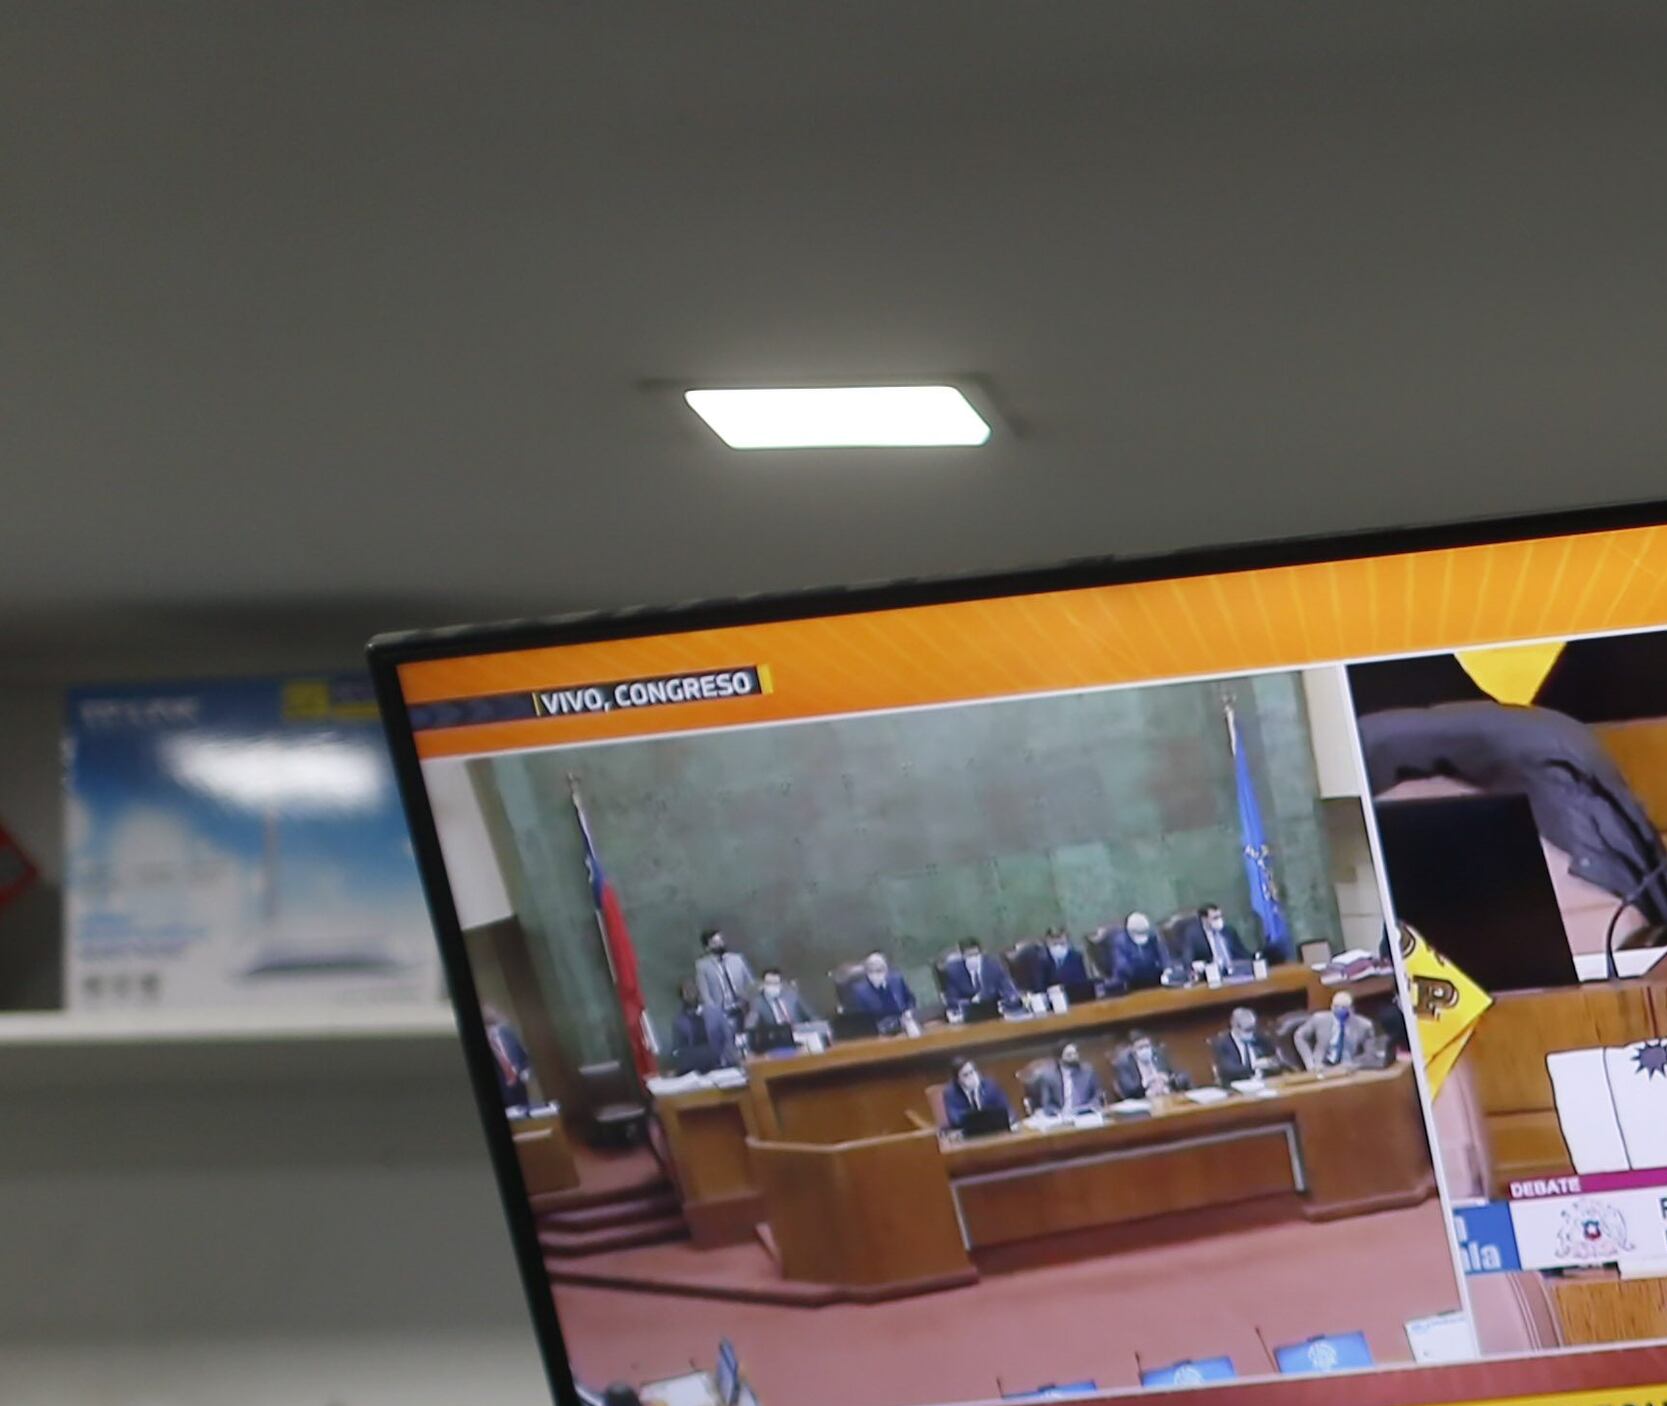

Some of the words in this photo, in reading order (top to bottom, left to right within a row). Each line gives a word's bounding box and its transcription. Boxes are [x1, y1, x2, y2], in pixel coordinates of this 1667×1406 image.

[541, 687, 610, 714] VIVO,
[613, 671, 751, 708] CONGRESO
[1510, 1176, 1581, 1199] DEBATE
